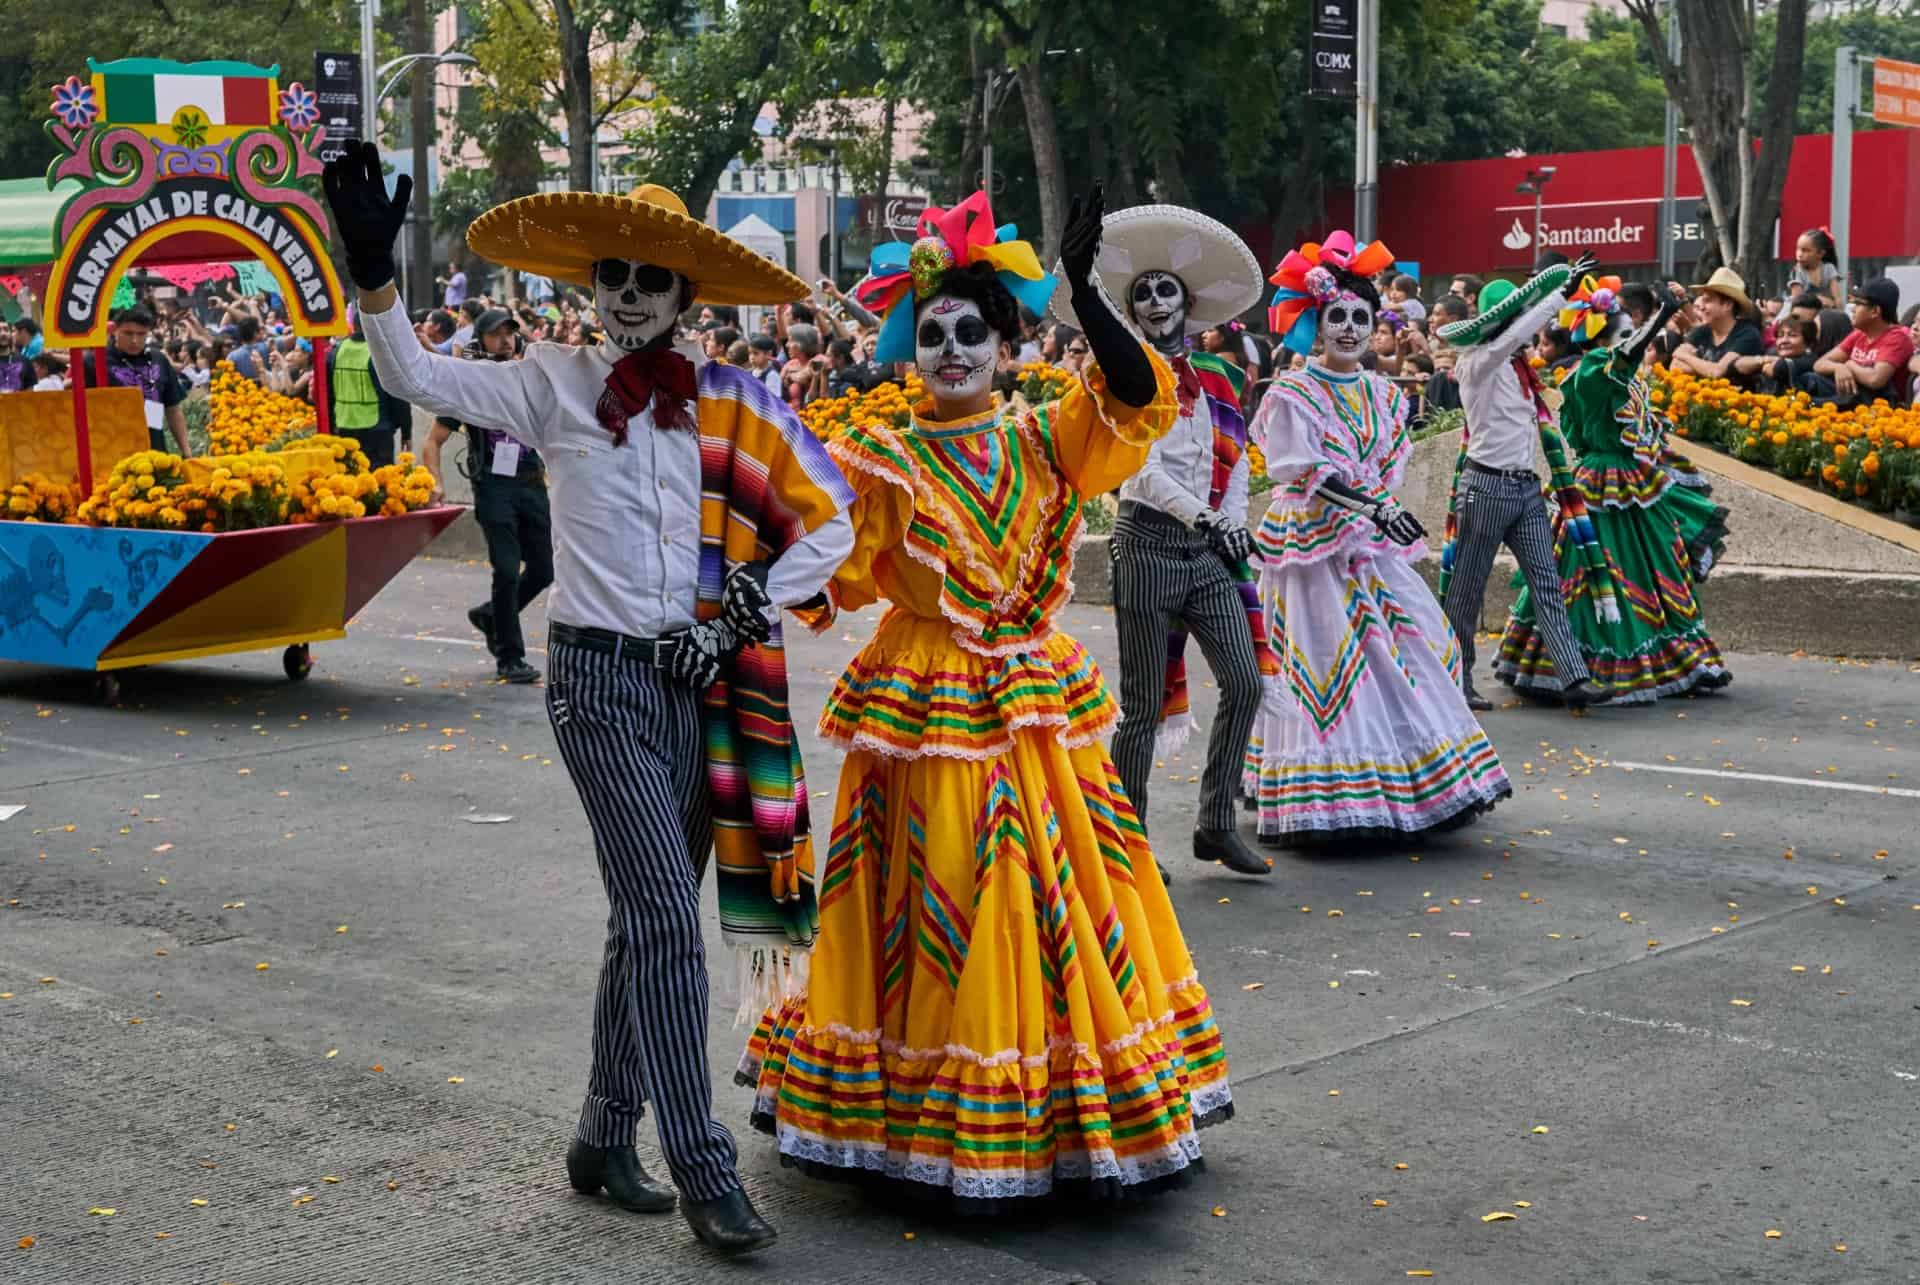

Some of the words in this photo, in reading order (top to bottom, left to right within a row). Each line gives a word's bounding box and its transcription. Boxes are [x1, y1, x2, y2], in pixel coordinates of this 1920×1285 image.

[1315, 51, 1352, 70] CDMX
[1537, 217, 1644, 247] Santander
[68, 197, 170, 321] CARNAVAL
[171, 190, 208, 217] DE
[214, 193, 329, 312] CALAVERAS
